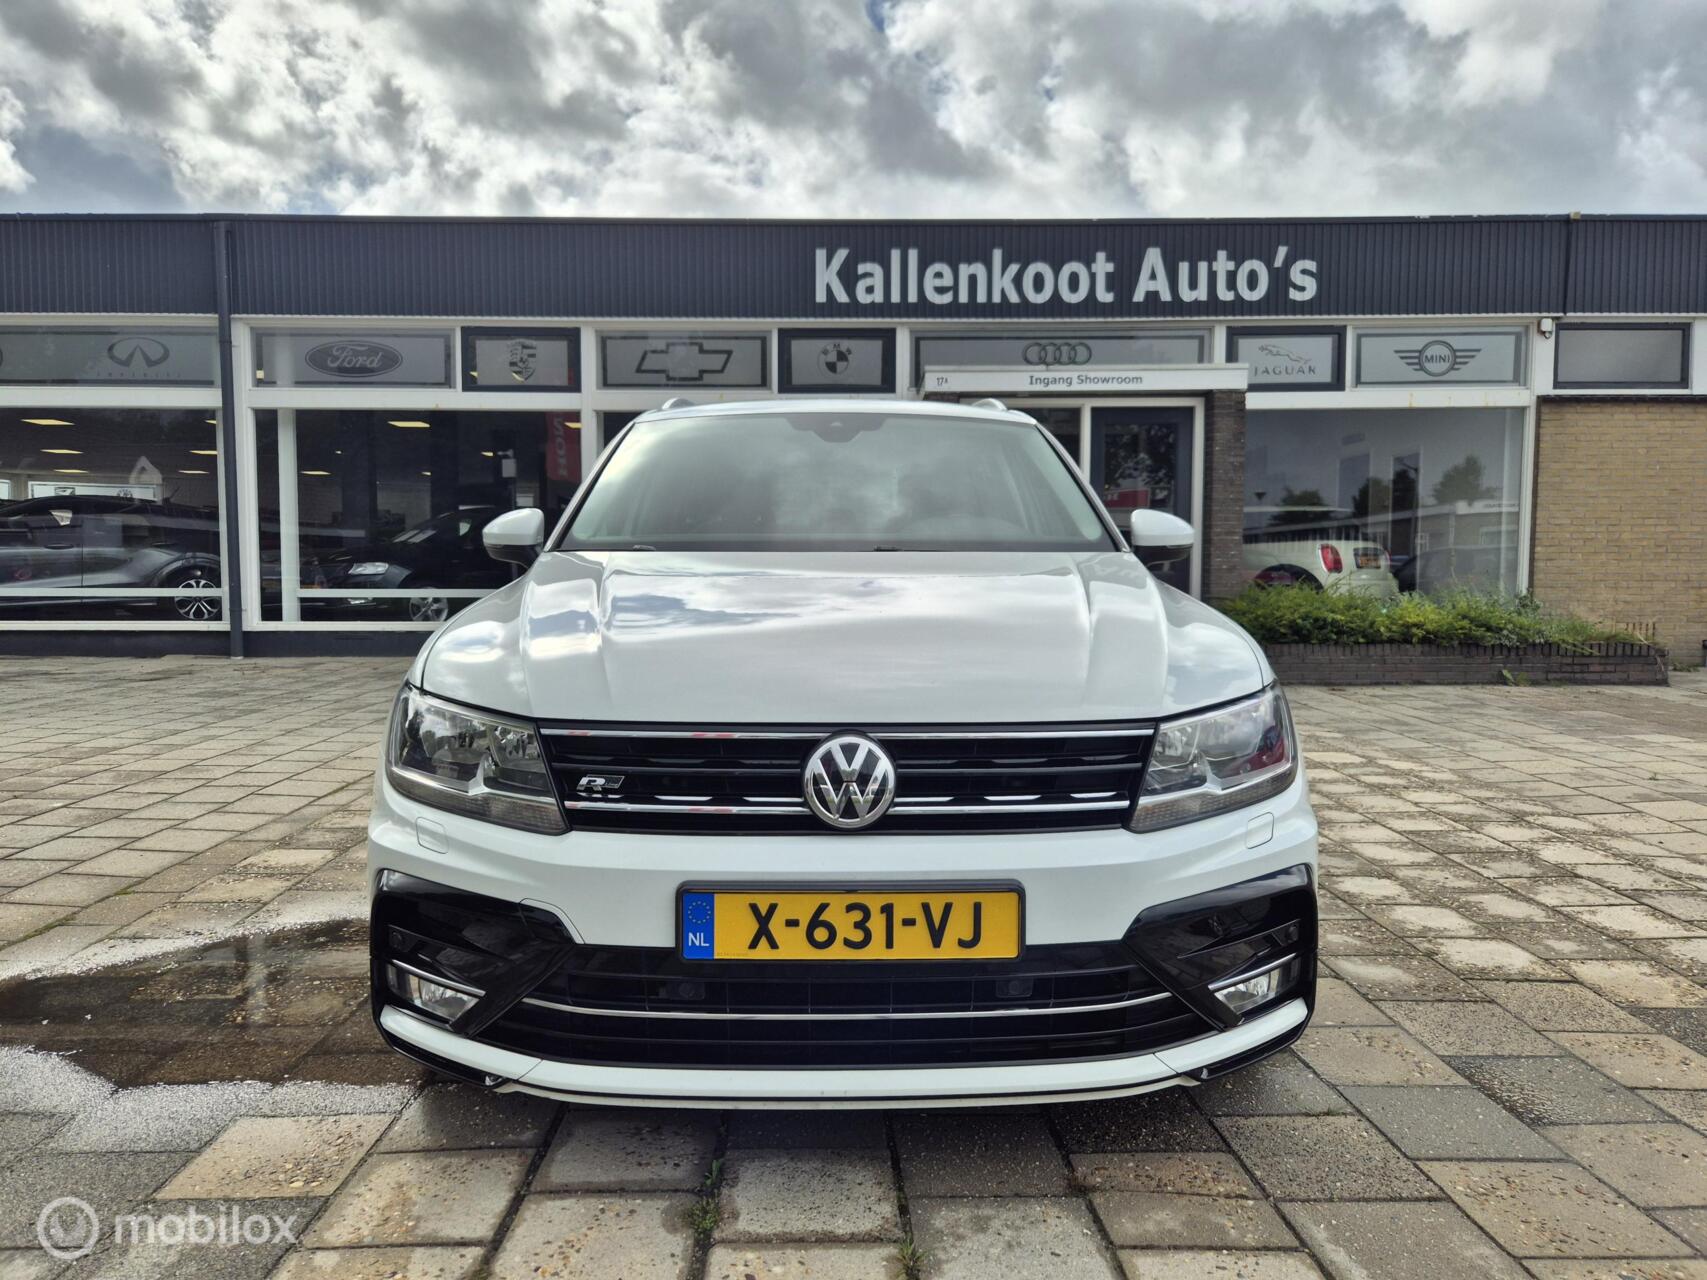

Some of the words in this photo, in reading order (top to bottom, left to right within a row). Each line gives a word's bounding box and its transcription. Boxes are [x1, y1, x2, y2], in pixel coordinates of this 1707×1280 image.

[815, 247, 1114, 304] Kallenkoot
[1132, 246, 1318, 302] Auto's
[327, 345, 384, 368] Ford
[1424, 354, 1450, 364] MINI
[1253, 365, 1317, 377] JAGUAR
[1029, 375, 1073, 387] Ingang
[1076, 374, 1143, 385] Showroom
[747, 902, 982, 950] X-631-VJ
[688, 932, 710, 947] NL
